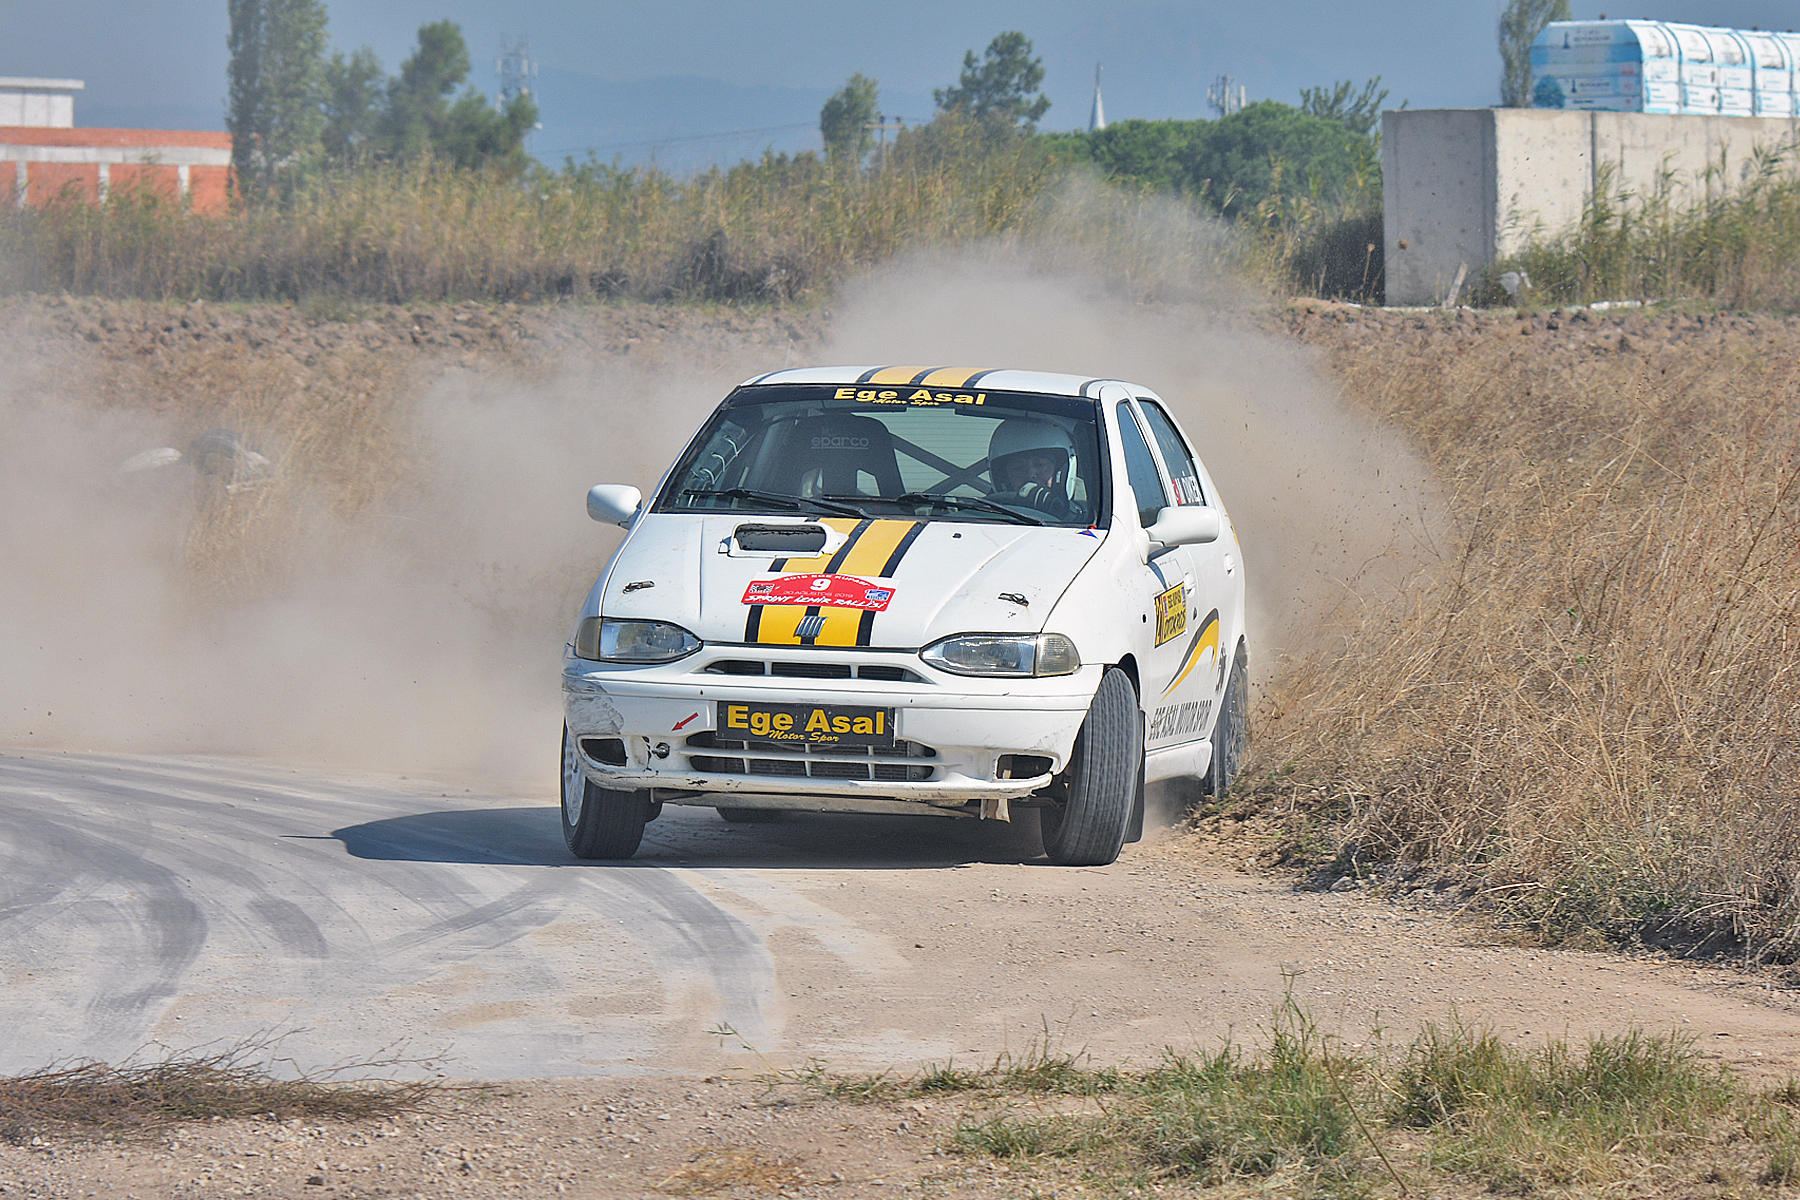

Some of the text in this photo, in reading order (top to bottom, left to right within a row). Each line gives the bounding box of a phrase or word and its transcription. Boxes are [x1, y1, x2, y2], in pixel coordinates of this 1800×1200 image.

[833, 388, 987, 405] Ege Asal
[810, 578, 832, 591] 9
[744, 595, 794, 603] SPRINT
[727, 704, 885, 736] Ege Asal
[768, 729, 840, 743] Motor Spor
